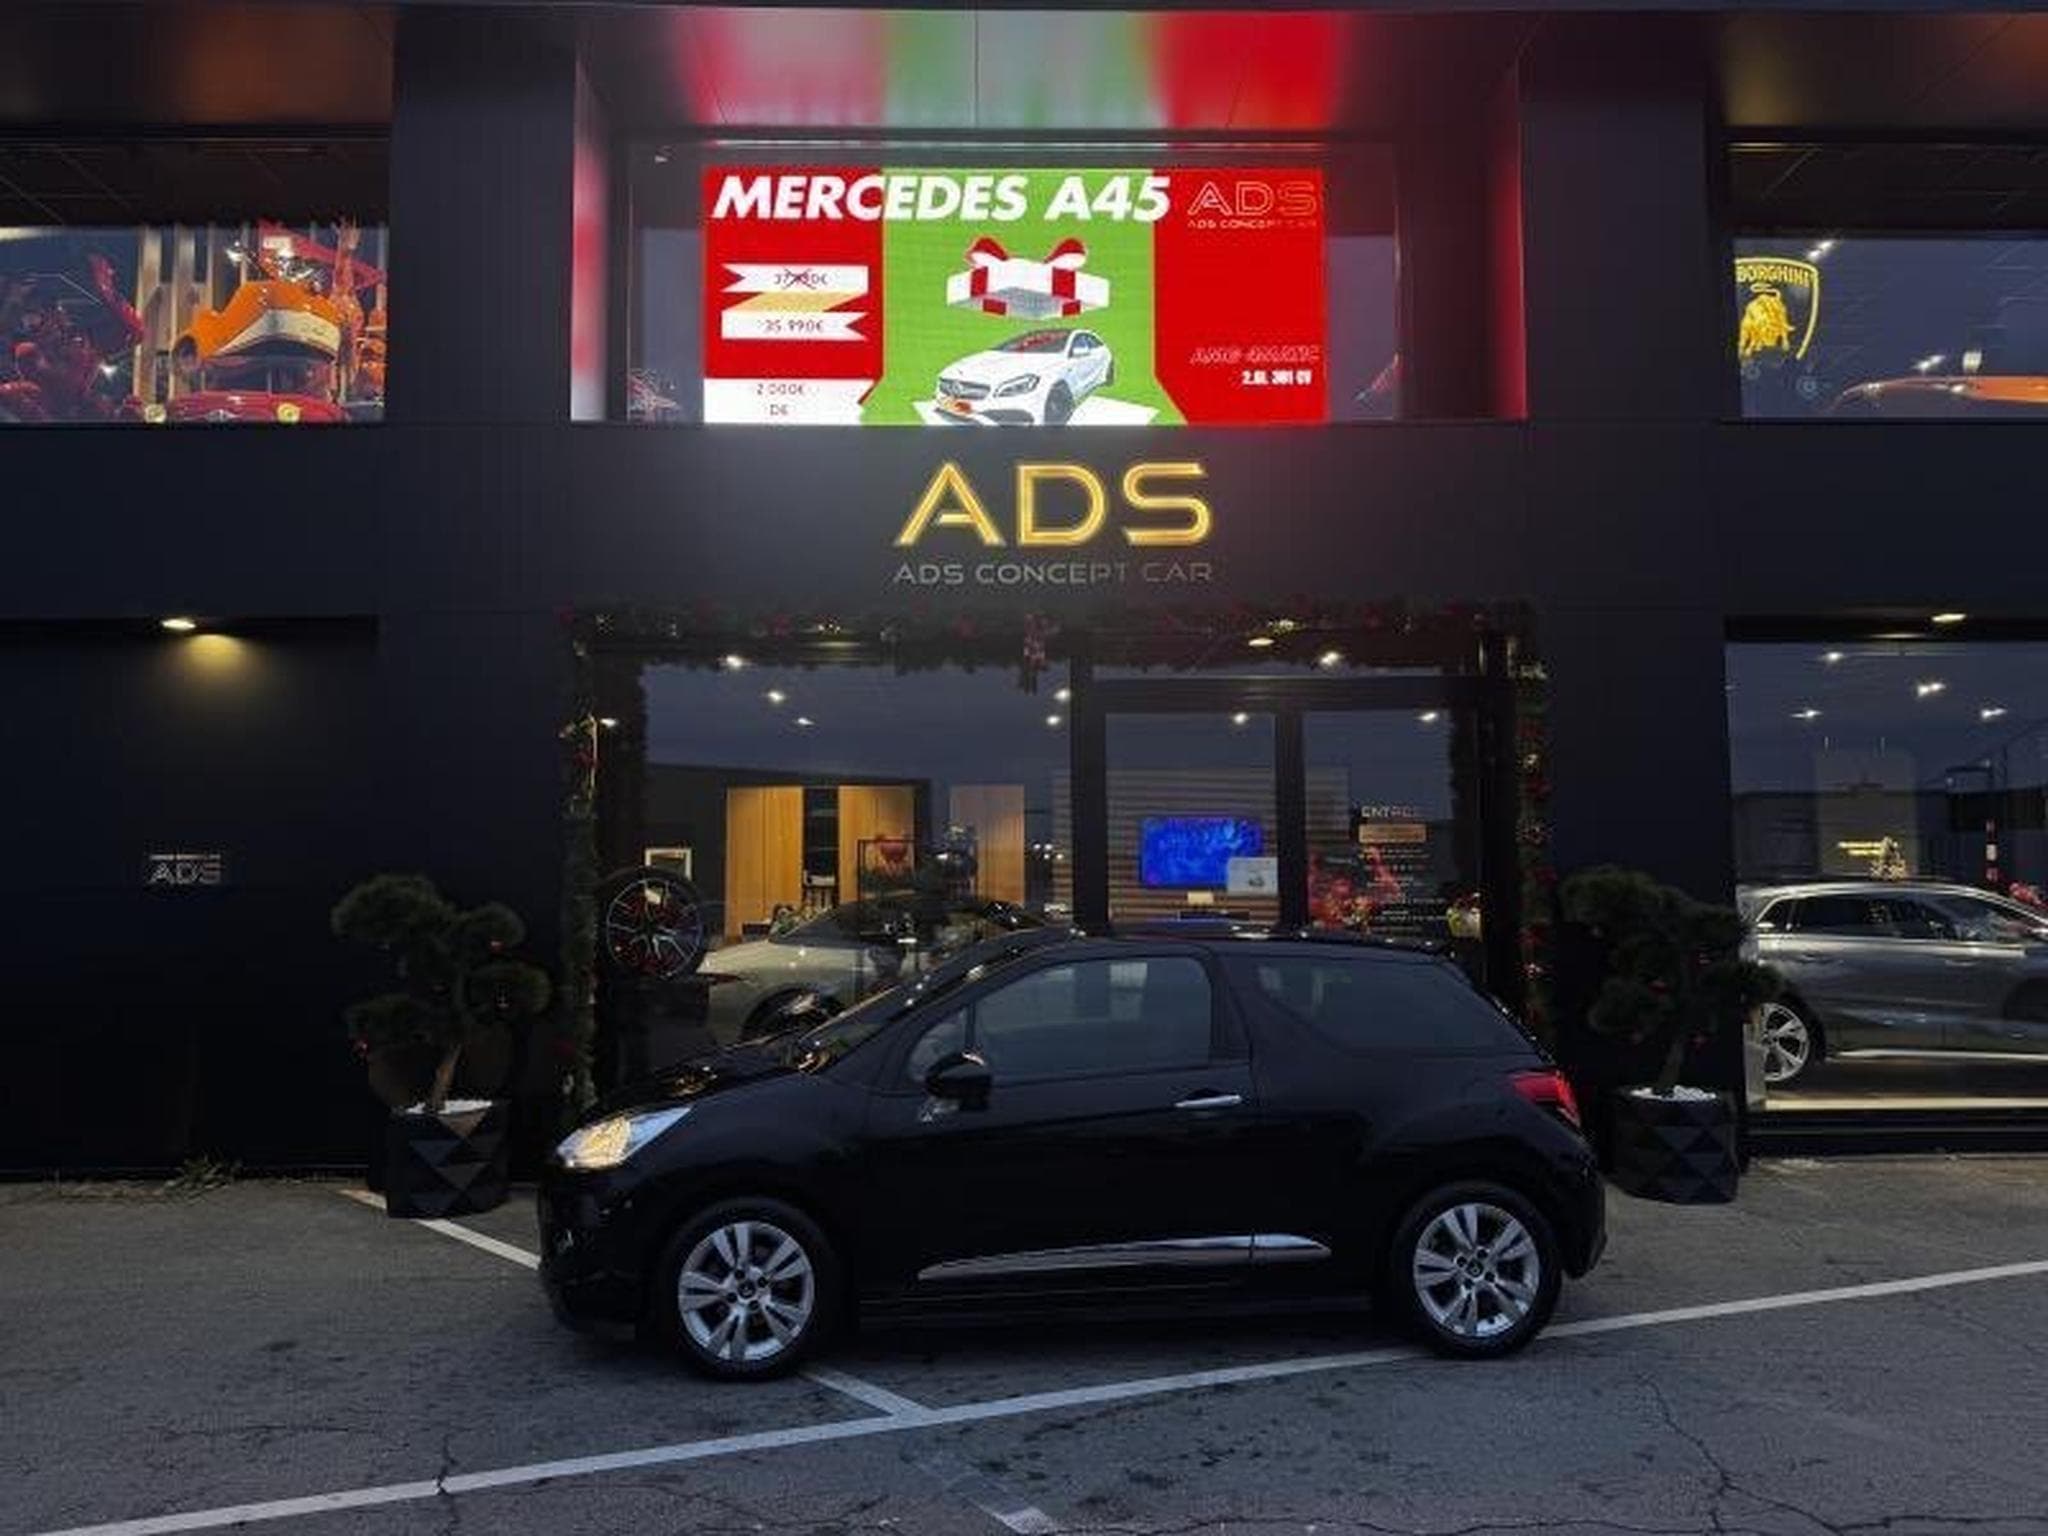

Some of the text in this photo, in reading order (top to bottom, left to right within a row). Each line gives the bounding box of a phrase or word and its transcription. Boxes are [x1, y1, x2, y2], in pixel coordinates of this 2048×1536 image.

[713, 175, 1171, 223] MERCEDES A45
[1187, 181, 1317, 216] ADS
[893, 461, 1213, 547] ADS
[893, 563, 1214, 585] ADS CONCEPT CAR
